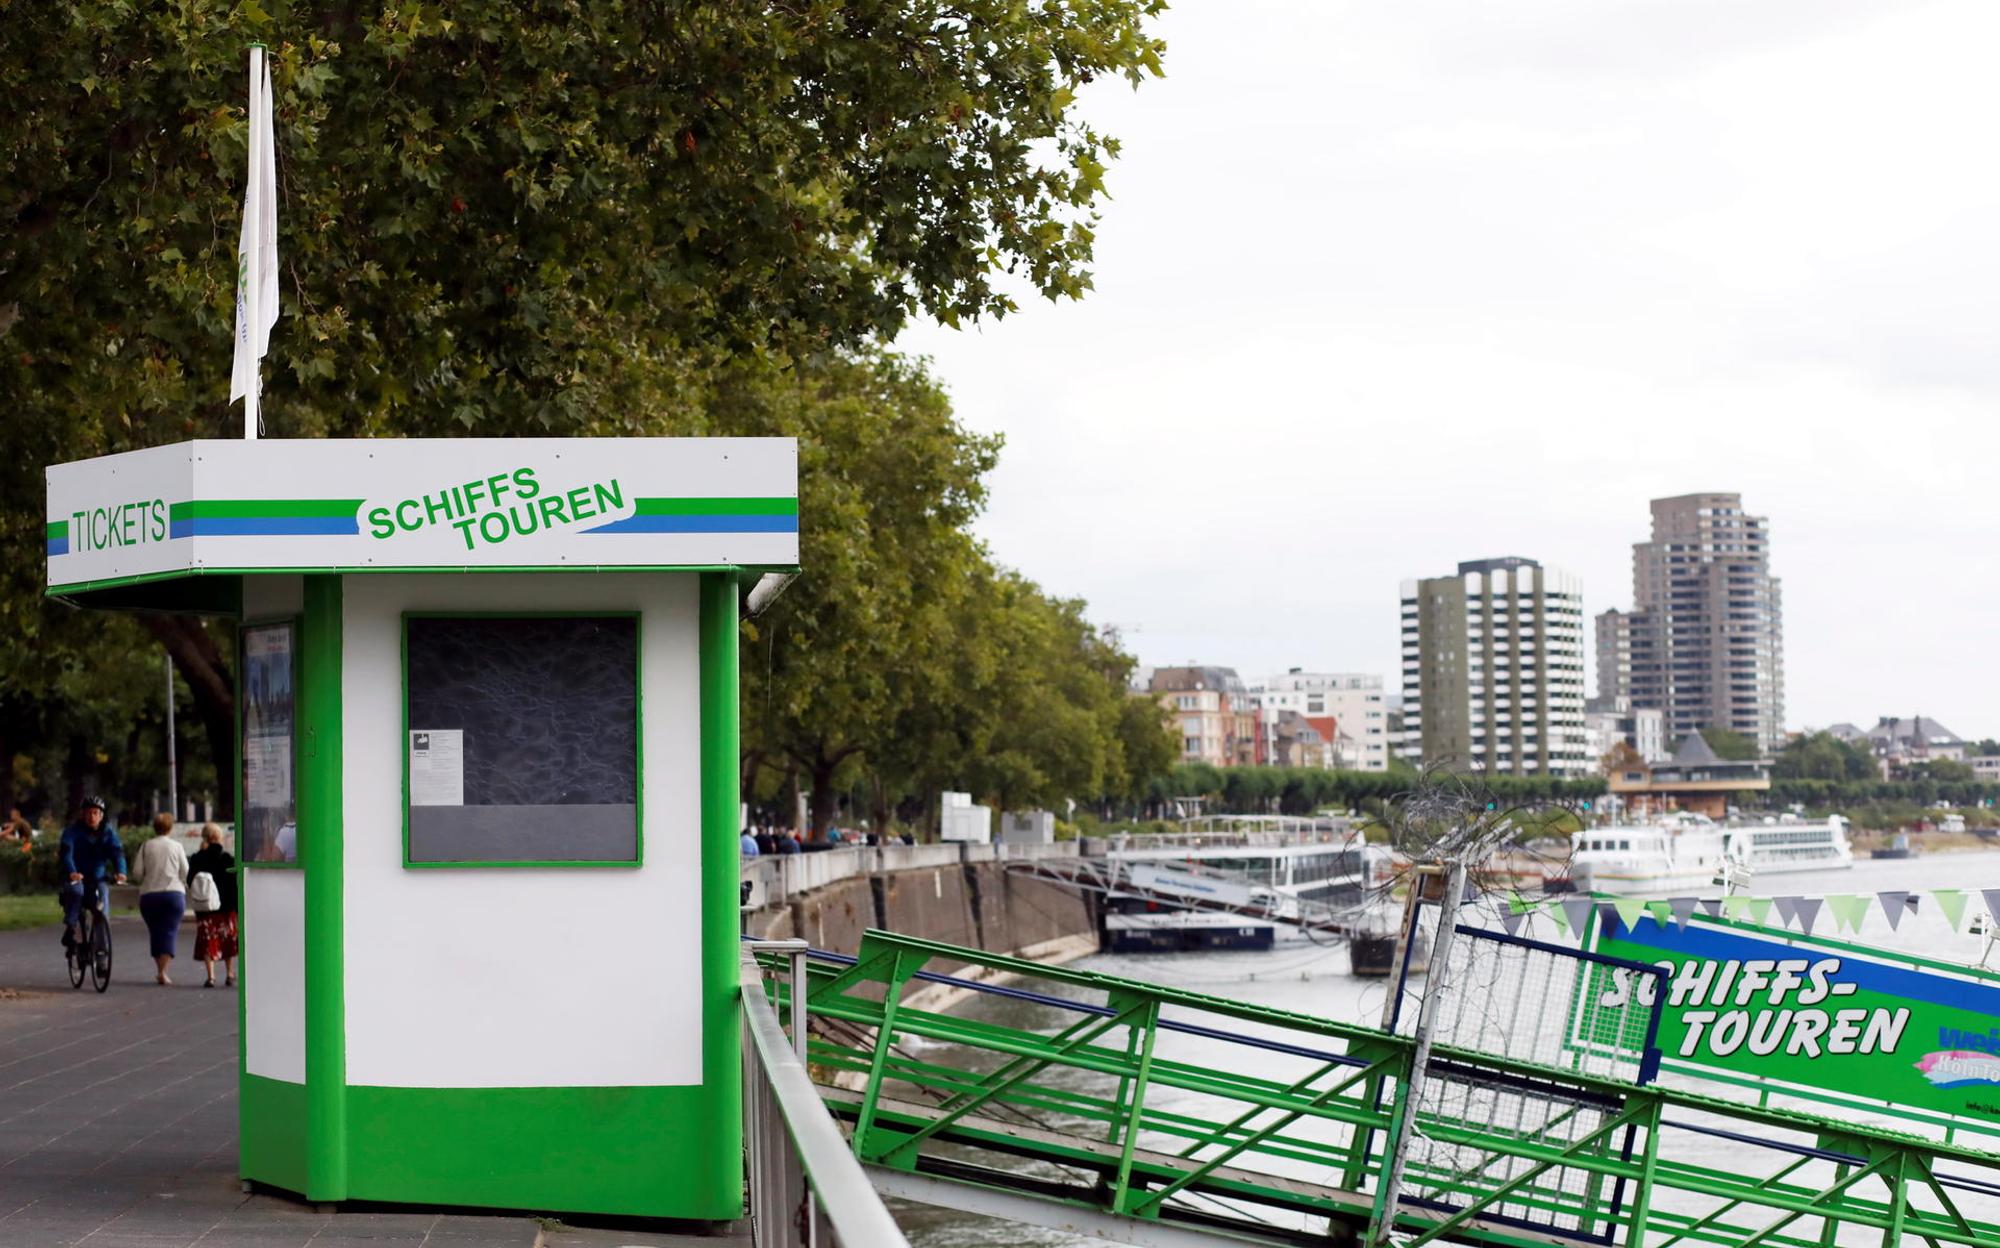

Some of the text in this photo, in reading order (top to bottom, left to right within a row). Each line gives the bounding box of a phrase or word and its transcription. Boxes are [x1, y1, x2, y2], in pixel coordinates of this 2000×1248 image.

[72, 498, 165, 552] TICKETS
[368, 467, 540, 539] SCHIFFS
[452, 479, 624, 551] TOUREN
[1600, 958, 1858, 1008] SCHIFFS-
[1678, 1007, 1911, 1059] TOUREN
